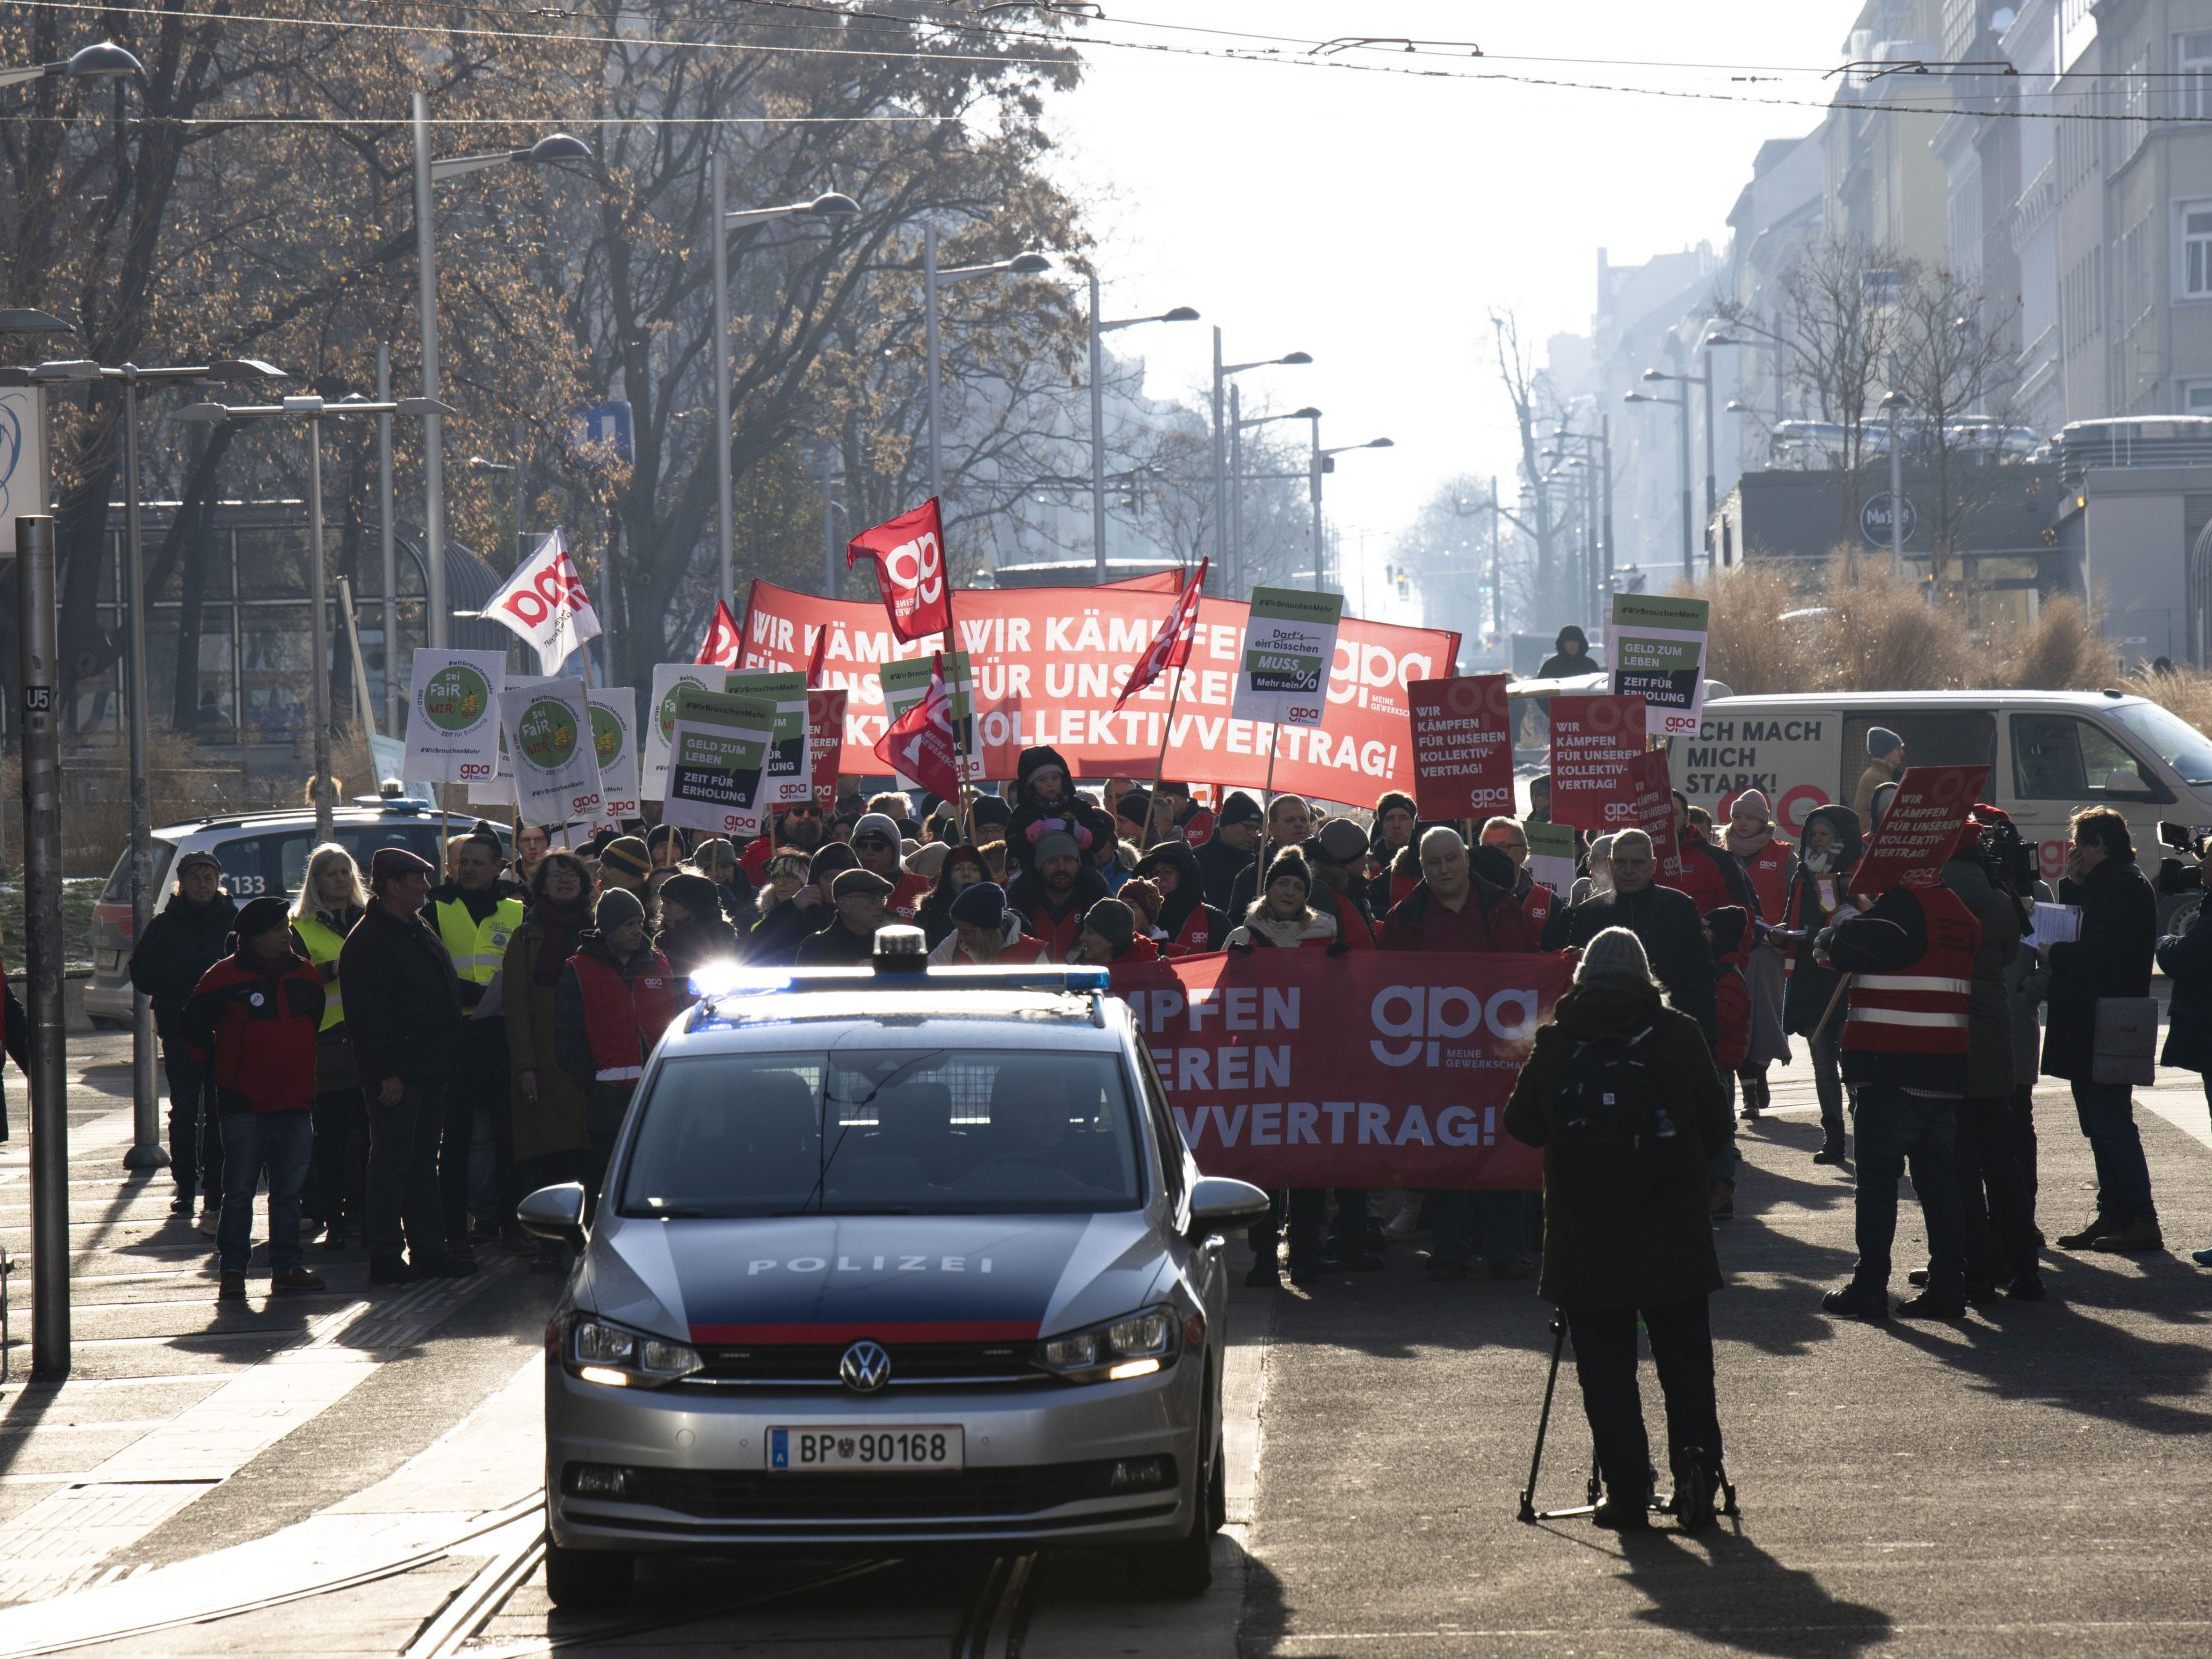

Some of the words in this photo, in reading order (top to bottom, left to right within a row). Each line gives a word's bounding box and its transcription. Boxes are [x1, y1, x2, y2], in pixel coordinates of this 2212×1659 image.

[1259, 599, 1334, 613] #WirBrauchenMehr
[1621, 606, 1700, 620] #WirBrauchenMehr
[754, 610, 794, 653] WIR
[960, 617, 1032, 654] WIR
[1273, 639, 1319, 654] bisschen
[1624, 643, 1655, 654] GELD
[1657, 645, 1682, 656] ZUM
[1257, 655, 1299, 672] MUSS
[1624, 656, 1660, 667] LEBEN
[429, 683, 462, 698] FaiR
[728, 682, 800, 694] #WirBrauchenMehr
[1256, 678, 1279, 689] Mehr
[1281, 681, 1300, 690] sein
[1623, 676, 1649, 687] ZEIT
[1651, 677, 1673, 689] FÜR
[26, 690, 49, 708] U5
[685, 702, 767, 720] #WirBrauchenMehr
[1288, 706, 1319, 723] gpa
[1416, 705, 1441, 717] WIR
[1417, 718, 1480, 732] KÄMPFEN
[1556, 721, 1580, 732] WIR
[1665, 716, 1697, 733] gpa
[1742, 721, 1822, 742] MACH
[686, 738, 717, 751] GELD
[720, 741, 747, 755] ZUM
[1418, 734, 1444, 748] FÜR
[1447, 731, 1505, 745] UNSEREN
[1556, 735, 1616, 747] KÄMPFEN
[421, 746, 481, 756] #WirBrauchenMehr
[685, 751, 722, 766] LEBEN
[1419, 747, 1494, 763] KOLLEKTIV-
[1556, 750, 1582, 761] FÜR
[1687, 748, 1756, 767] MICH
[460, 763, 491, 780] gpa
[1420, 763, 1483, 777] VERTRAG!
[1557, 765, 1629, 776] KOLLEKTIV-
[683, 771, 709, 785] ZEIT
[711, 775, 734, 788] FÜR
[1557, 779, 1617, 790] VERTRAG!
[1685, 773, 1777, 794] STARK!
[682, 785, 747, 802] ERHOLUNG
[779, 783, 807, 799] gpa
[1471, 787, 1508, 808] gpa
[1900, 794, 1923, 804] WIR
[572, 793, 601, 814] gpa
[606, 801, 636, 817] gpa
[1892, 807, 1949, 818] KÄMPFEN
[723, 814, 756, 831] gpa
[1911, 820, 1962, 832] UNSEREN
[1873, 848, 1930, 858] VERTRAG!
[231, 875, 266, 895] 133
[1370, 985, 1538, 1067] gpa
[1447, 1049, 1482, 1058] MEINE
[748, 1256, 993, 1276] POLIZEI
[800, 1435, 835, 1463] BP
[859, 1433, 946, 1462] 90168
